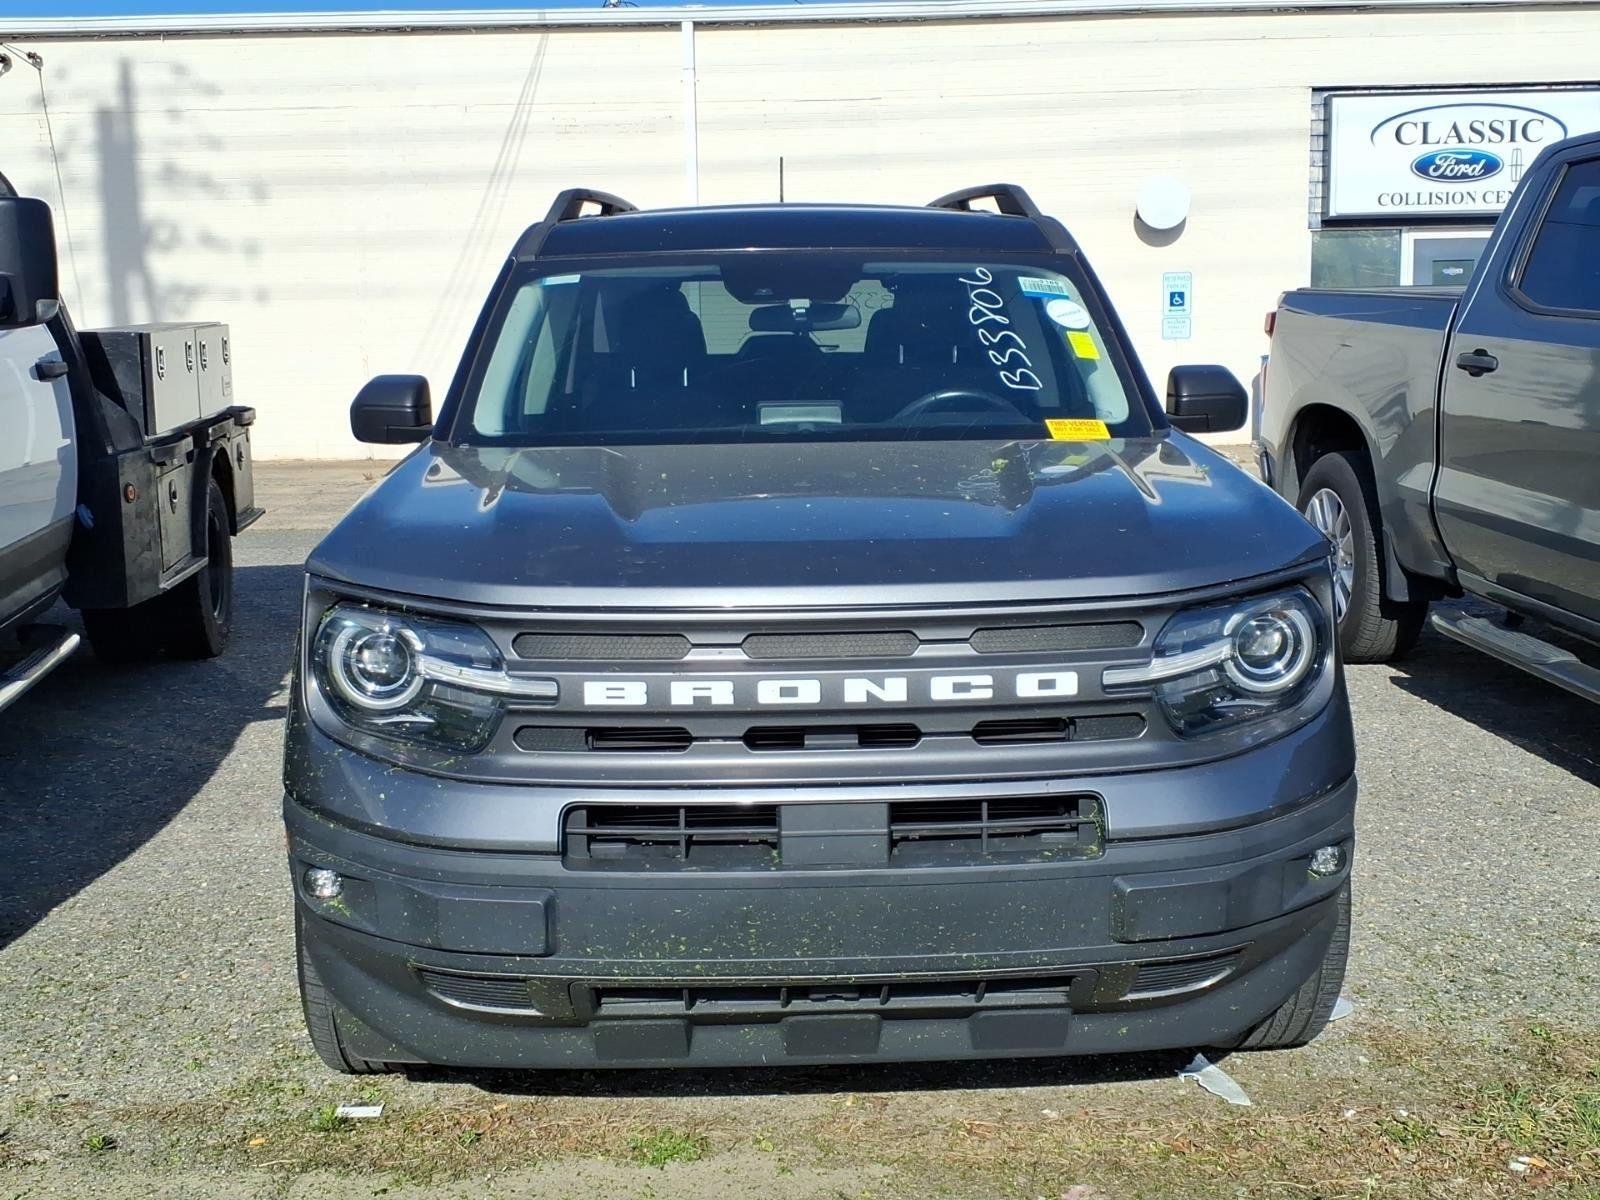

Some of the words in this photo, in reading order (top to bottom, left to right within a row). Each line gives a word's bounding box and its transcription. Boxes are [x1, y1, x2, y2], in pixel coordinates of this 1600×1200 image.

[1395, 119, 1544, 145] CLASSIC
[1429, 153, 1486, 177] Ford
[1377, 190, 1477, 207] COLLISION
[959, 267, 1043, 390] B33806
[583, 671, 1079, 706] BRONCO
